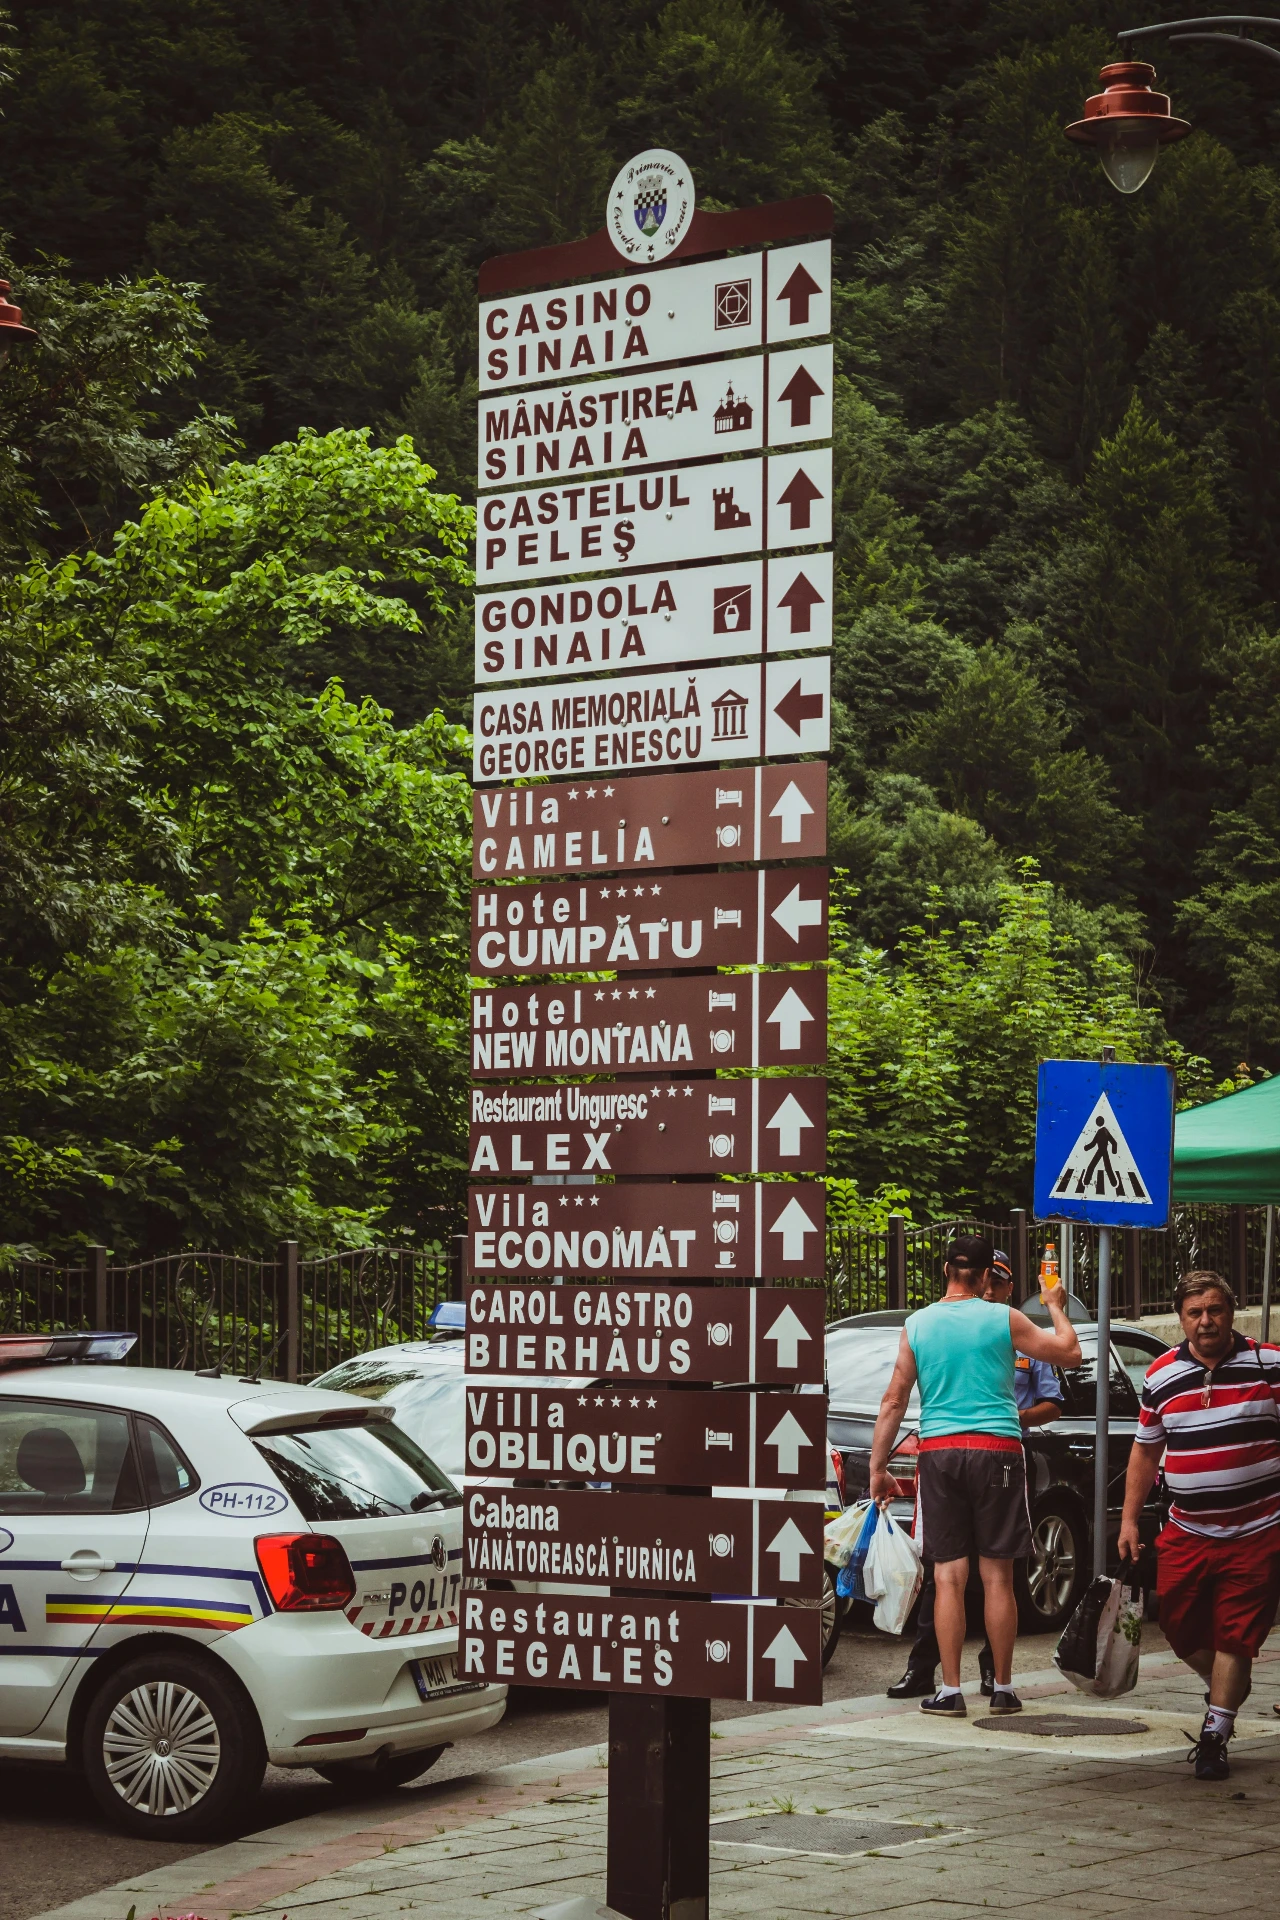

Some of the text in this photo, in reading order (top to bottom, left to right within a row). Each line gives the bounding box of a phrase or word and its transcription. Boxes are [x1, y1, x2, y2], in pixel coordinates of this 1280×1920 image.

[626, 162, 676, 184] Primaria
[485, 283, 651, 341] CASINO
[487, 325, 649, 381] SINAIA
[485, 379, 698, 443] MÂNĂSTIREA
[485, 427, 648, 480] SINAIA
[483, 474, 690, 532] CASTELUL
[482, 580, 677, 632] GONDOLA
[483, 624, 646, 673] SINAIA
[480, 676, 701, 737] CASA MEMORIALĂ
[479, 725, 702, 777] GEORGE ENESCU
[480, 791, 560, 828] Vila
[479, 826, 655, 872] CAMELIA
[477, 887, 587, 927] Hotel
[477, 914, 703, 969] CUMPĂTU
[473, 989, 582, 1029] Hotel
[473, 1023, 694, 1070] NEW MONTANA
[472, 1087, 648, 1129] Restaurant Unguresc
[470, 1132, 612, 1172] ALEX
[475, 1193, 549, 1227] Vila
[474, 1229, 696, 1269] ECONOMAT
[470, 1289, 693, 1328] CAROL GASTRO
[469, 1333, 691, 1374] BIERHAUS
[467, 1392, 565, 1428] Villa
[468, 1430, 656, 1476] OBLIQUE
[210, 1491, 276, 1511] PH-112
[468, 1493, 559, 1532] Cabana
[467, 1531, 697, 1583] VÂNĂTOREASCĂ FURNICA
[465, 1597, 680, 1643] Restaurant
[423, 1660, 448, 1688] MAI
[464, 1637, 673, 1687] REGALES
